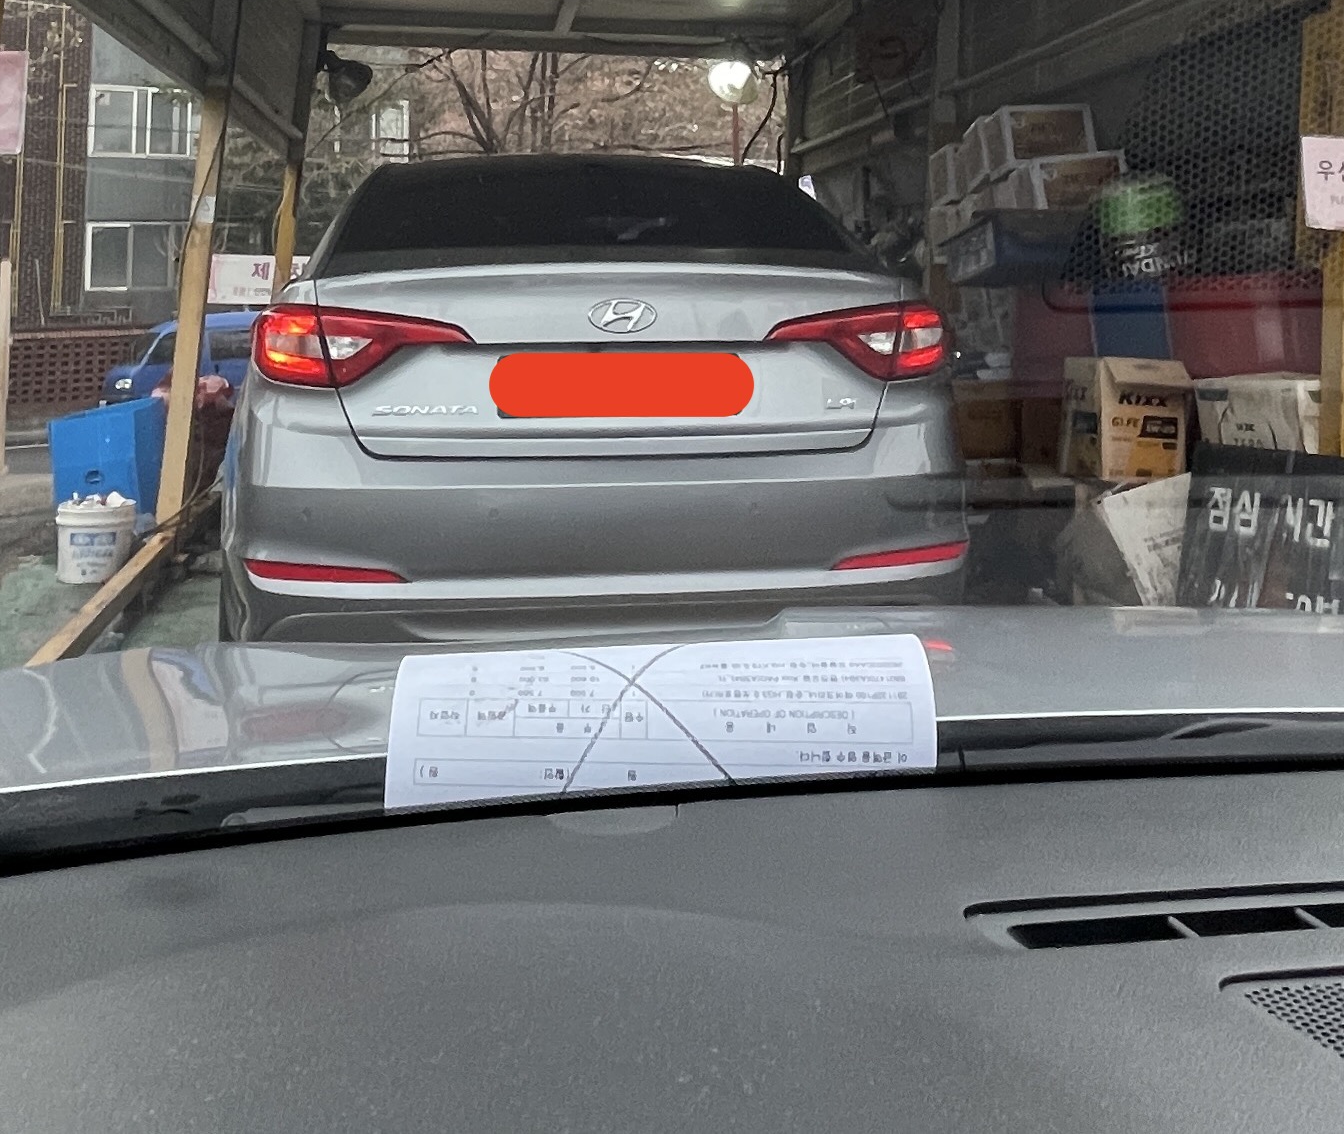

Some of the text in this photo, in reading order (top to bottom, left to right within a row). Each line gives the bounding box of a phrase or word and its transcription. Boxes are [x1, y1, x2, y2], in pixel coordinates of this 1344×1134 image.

[372, 404, 479, 416] SONATA
[1206, 486, 1336, 548] 점심 시간
